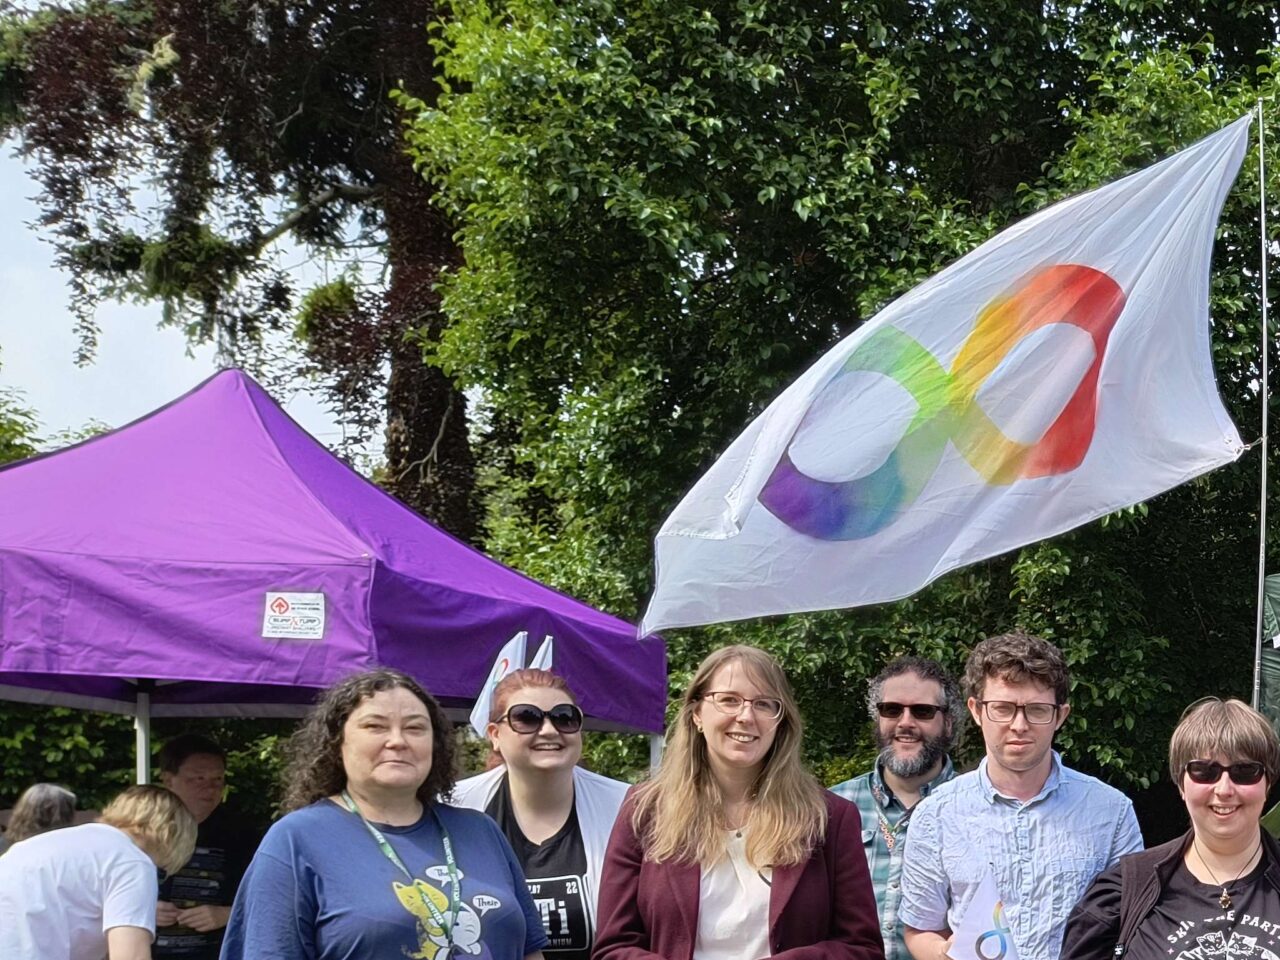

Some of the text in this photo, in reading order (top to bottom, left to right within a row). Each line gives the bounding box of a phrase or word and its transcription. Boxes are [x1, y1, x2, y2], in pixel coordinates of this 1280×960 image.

[565, 881, 578, 894] 22
[533, 898, 570, 935] Ti
[548, 938, 572, 946] ANIUM
